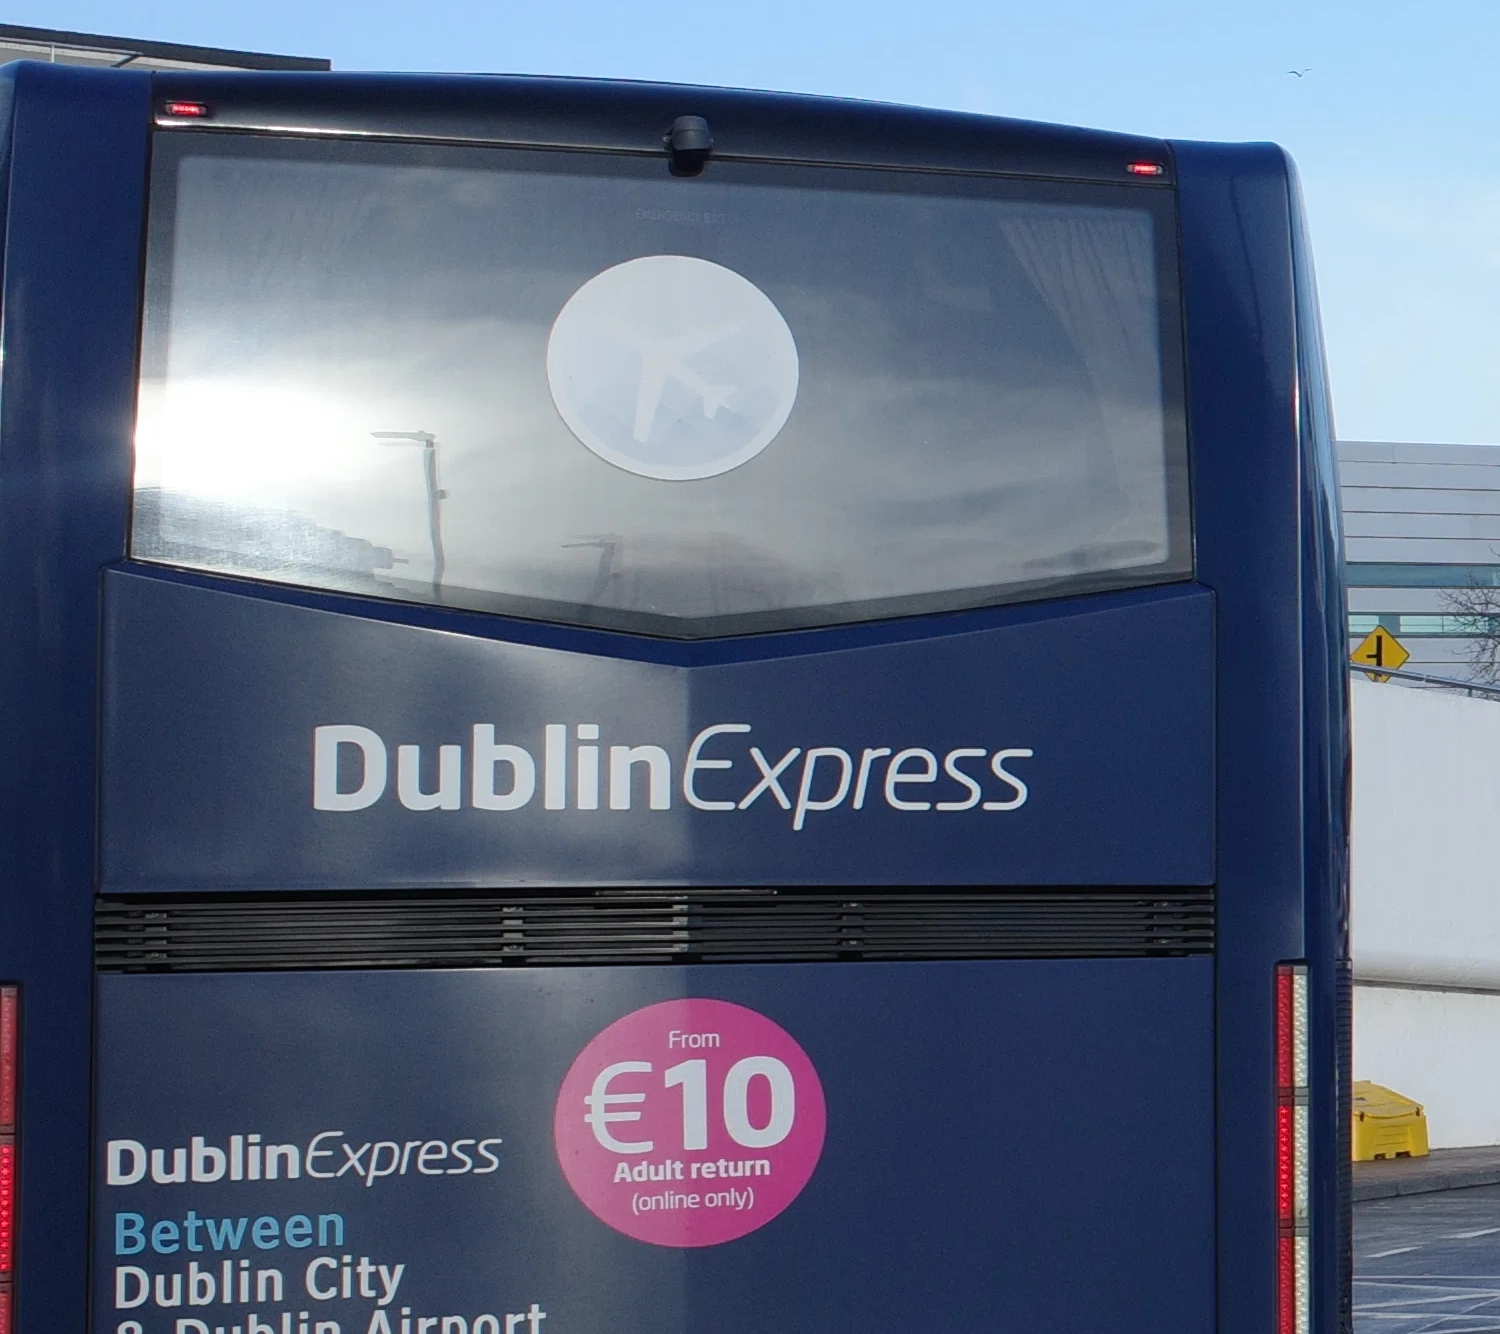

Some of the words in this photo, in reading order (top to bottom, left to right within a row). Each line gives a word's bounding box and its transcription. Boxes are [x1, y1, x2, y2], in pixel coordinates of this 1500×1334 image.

[312, 723, 1034, 831] DublinExpress
[668, 1030, 720, 1049] From
[584, 1056, 795, 1154] €10
[107, 1131, 503, 1187] DublinExpress
[613, 1159, 684, 1183] Adult
[690, 1158, 771, 1180] return
[631, 1190, 700, 1215] (online
[704, 1187, 755, 1210] only)
[115, 1210, 345, 1255] Between
[115, 1259, 285, 1309] Dublin
[305, 1256, 405, 1307] City
